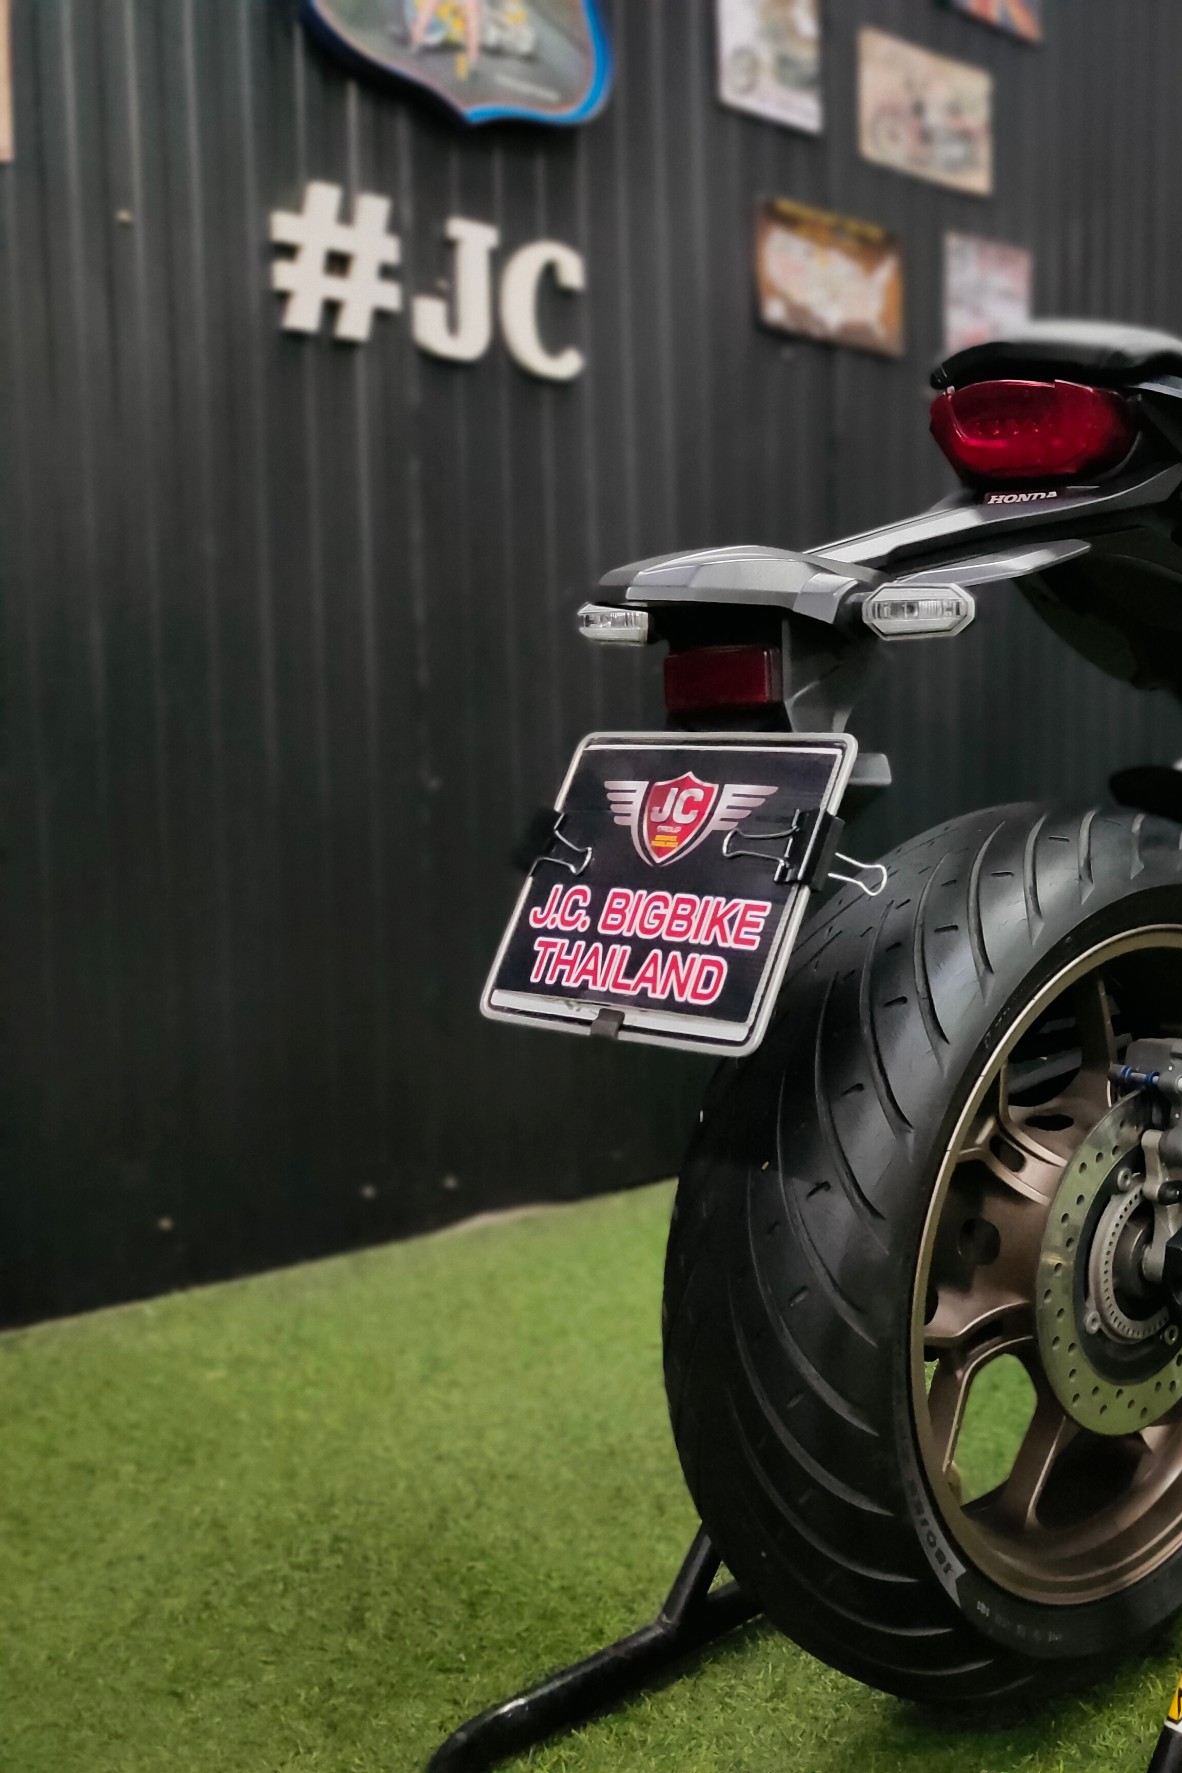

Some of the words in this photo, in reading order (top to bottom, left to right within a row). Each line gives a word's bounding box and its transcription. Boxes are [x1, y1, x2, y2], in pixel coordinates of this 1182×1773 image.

[987, 491, 1058, 504] HONDA
[650, 787, 704, 824] JC
[529, 884, 592, 931] J.C.
[598, 887, 773, 951] BIGBIKE
[530, 937, 728, 1005] THAILAND
